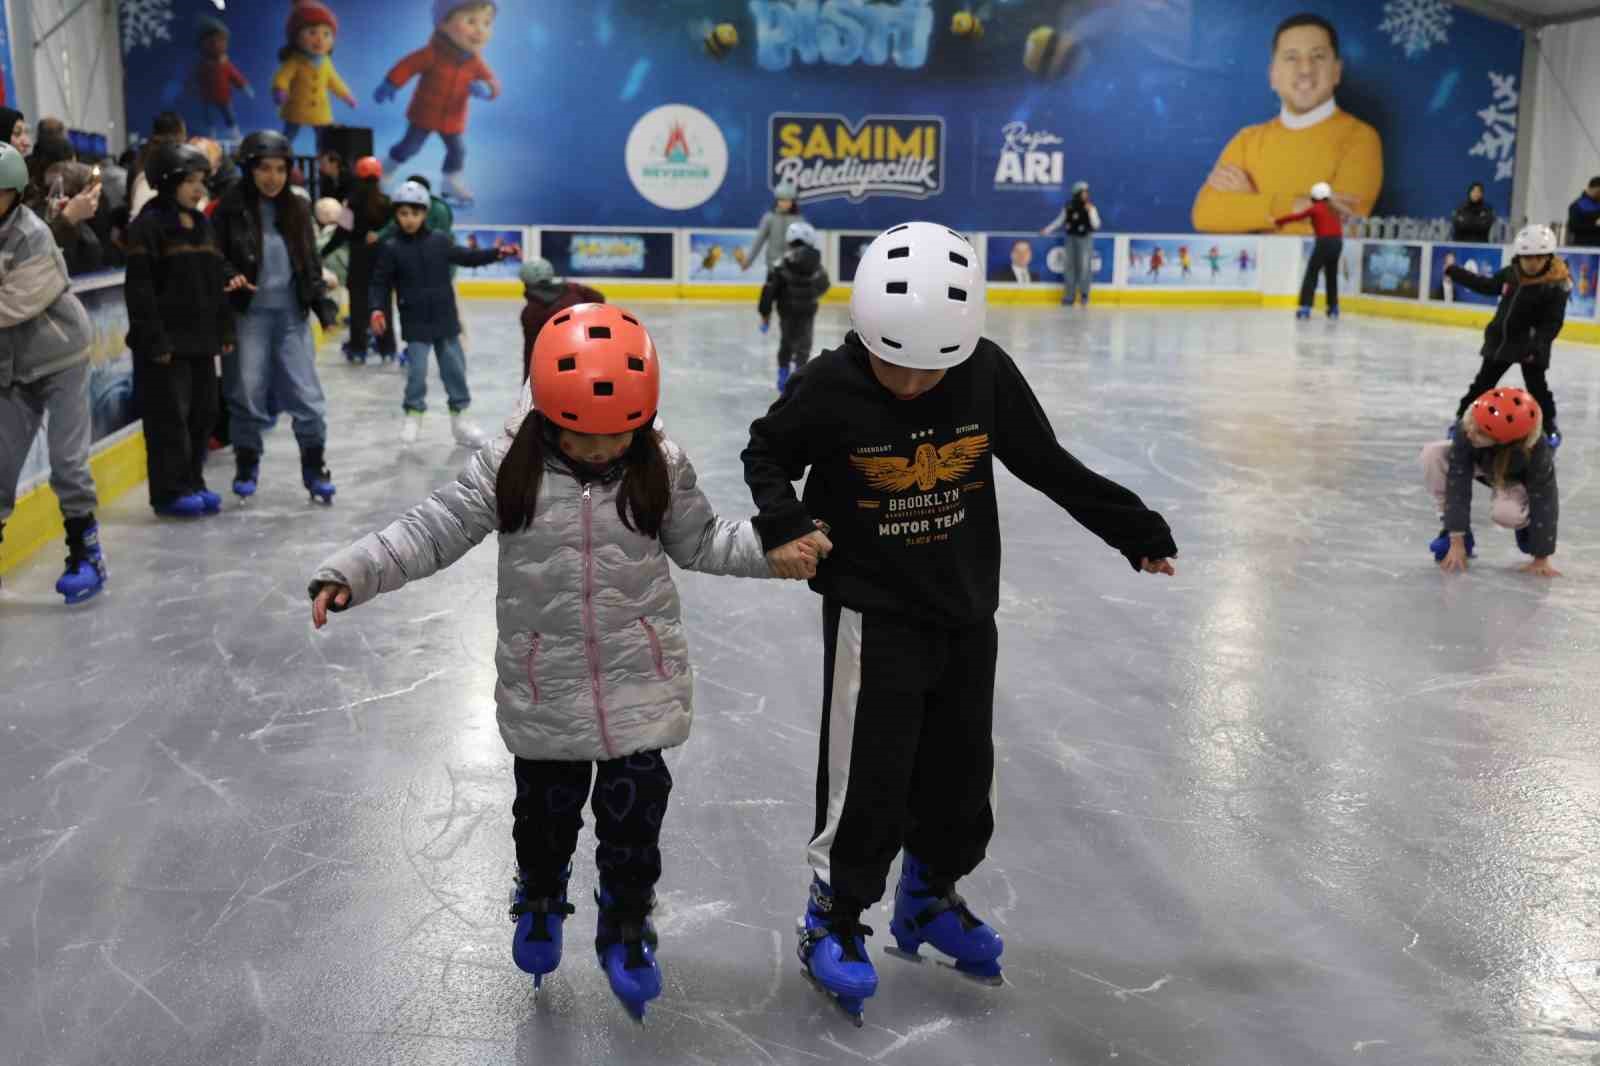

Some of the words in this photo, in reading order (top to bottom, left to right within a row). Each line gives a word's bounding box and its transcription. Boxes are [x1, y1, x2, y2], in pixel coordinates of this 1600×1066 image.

[775, 157, 938, 197] Belediyecilik
[994, 151, 1064, 184] ARI
[889, 488, 959, 512] BROOKLYN
[878, 520, 930, 537] MOTOR
[934, 507, 965, 530] TEAM
